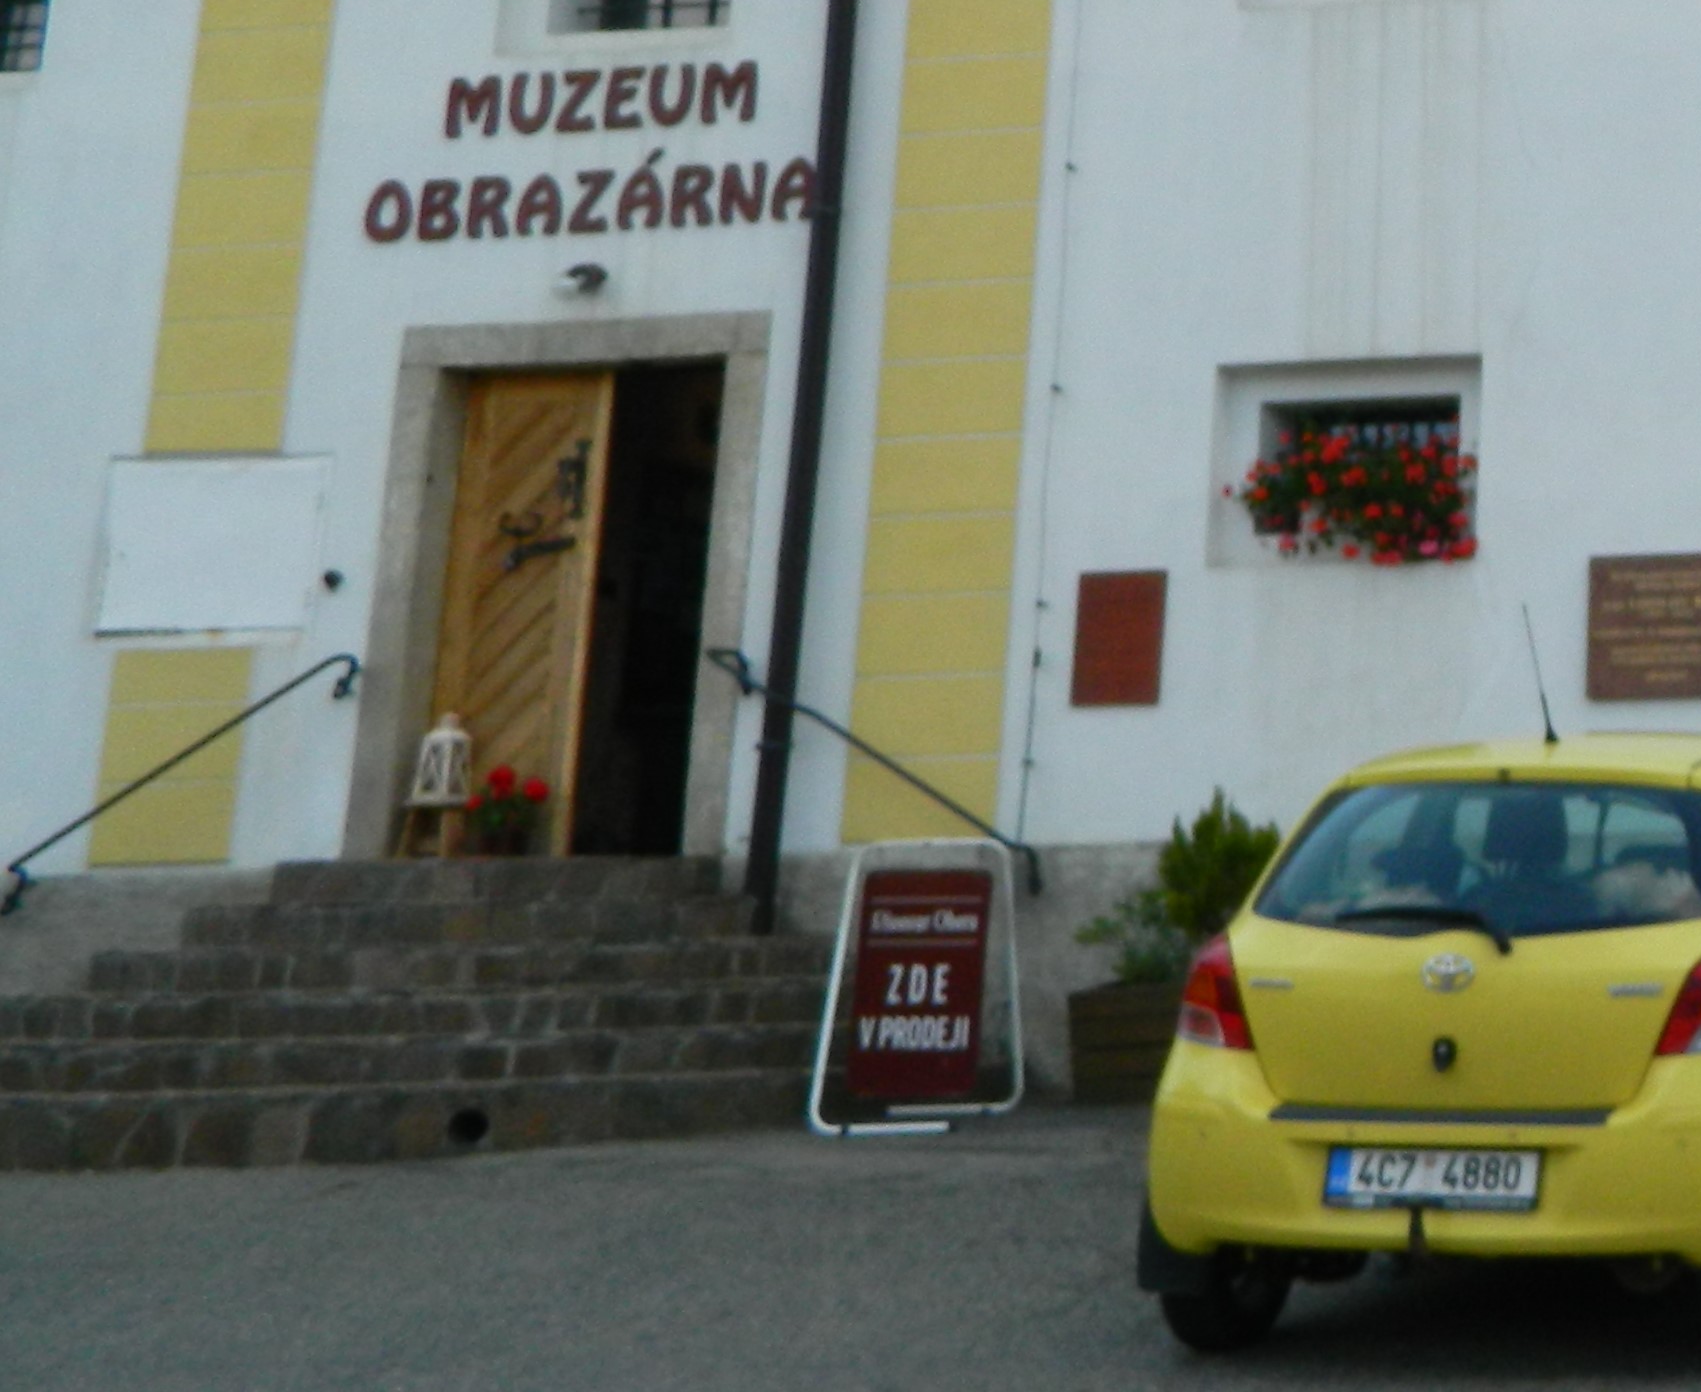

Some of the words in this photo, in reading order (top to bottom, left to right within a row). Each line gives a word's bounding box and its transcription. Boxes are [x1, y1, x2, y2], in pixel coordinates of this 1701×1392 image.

[445, 60, 758, 139] MUZEUM
[364, 147, 817, 243] OBRAZÁRNA
[885, 963, 951, 1005] ZDE
[860, 1016, 876, 1051] V
[877, 1015, 970, 1050] PRODEJI
[1357, 1154, 1418, 1189] 4C7
[1441, 1154, 1521, 1190] 4880
